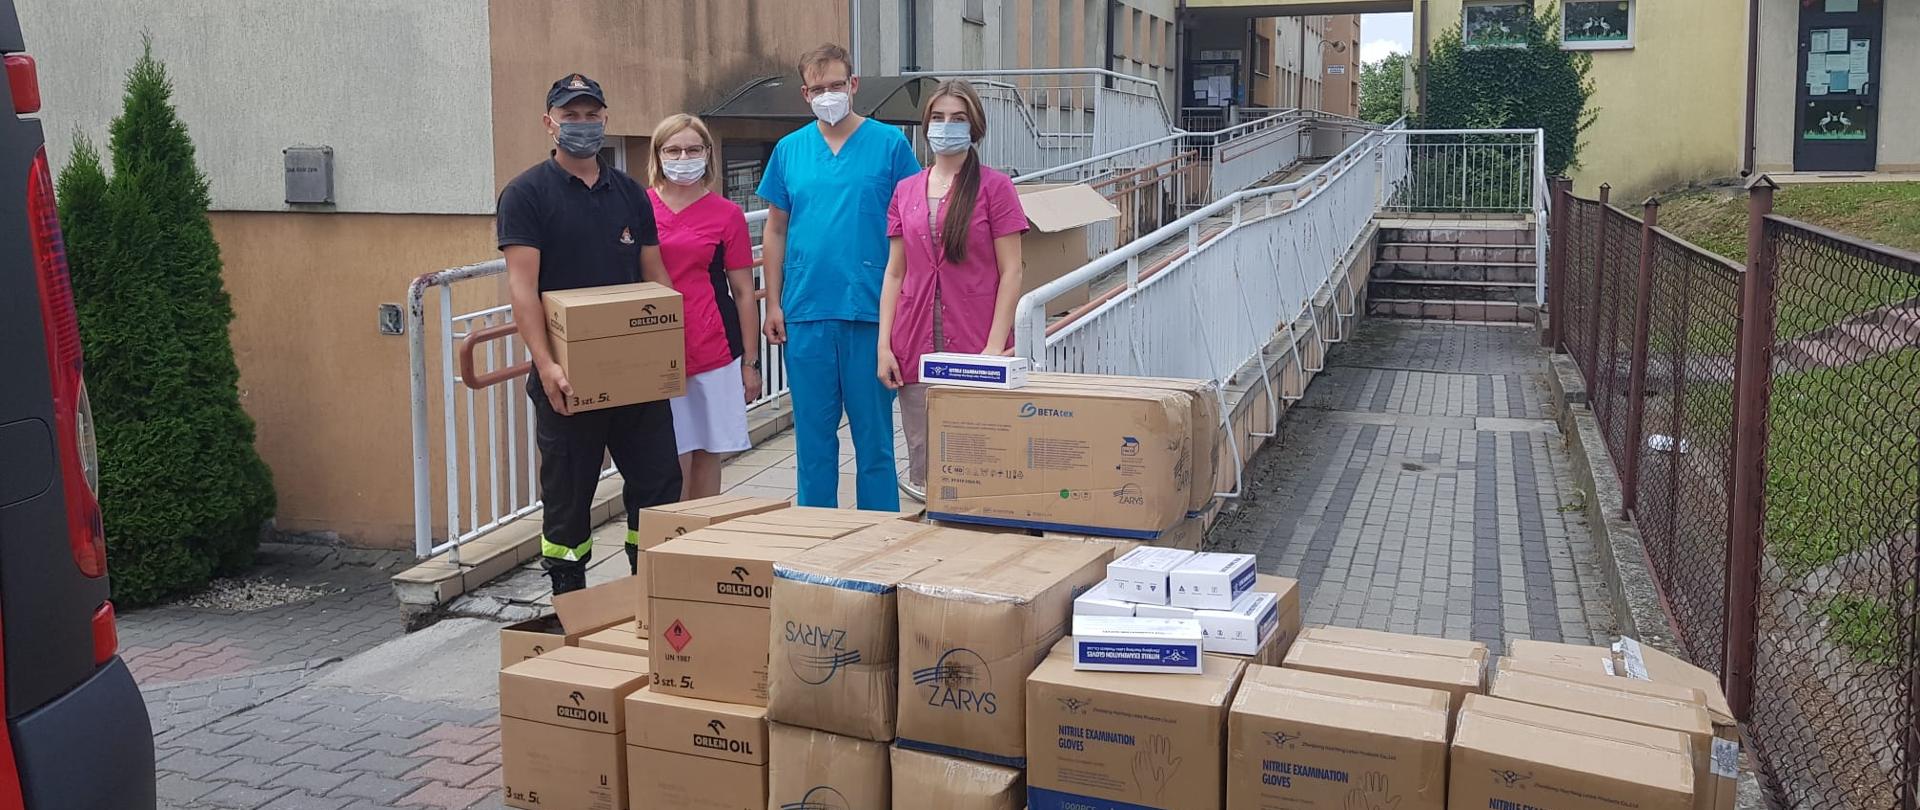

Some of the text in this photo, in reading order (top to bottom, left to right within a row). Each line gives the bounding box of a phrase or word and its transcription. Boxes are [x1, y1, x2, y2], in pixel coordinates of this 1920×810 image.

[630, 314, 678, 327] ORLEN OIL
[573, 397, 580, 406] 3
[582, 397, 594, 406] szt.
[1119, 495, 1144, 505] ZARYS
[717, 582, 751, 597] ORLEN
[785, 620, 847, 650] ZARYS
[664, 653, 675, 661] UN
[1106, 651, 1140, 659] EXAMINATION
[653, 672, 661, 685] 3
[661, 677, 677, 687] szt.
[928, 685, 997, 715] ZARYS
[557, 705, 609, 724] ORLEN OIL
[1058, 725, 1136, 746] NITRILE EXAMINATION
[693, 734, 753, 755] ORLEN OIL
[1058, 737, 1084, 752] GLOVES
[1262, 759, 1349, 784] NITRILE EXAMINATION
[600, 774, 607, 785] U
[1262, 775, 1291, 788] GLOVES
[506, 786, 512, 797] 3
[513, 790, 526, 801] szt.
